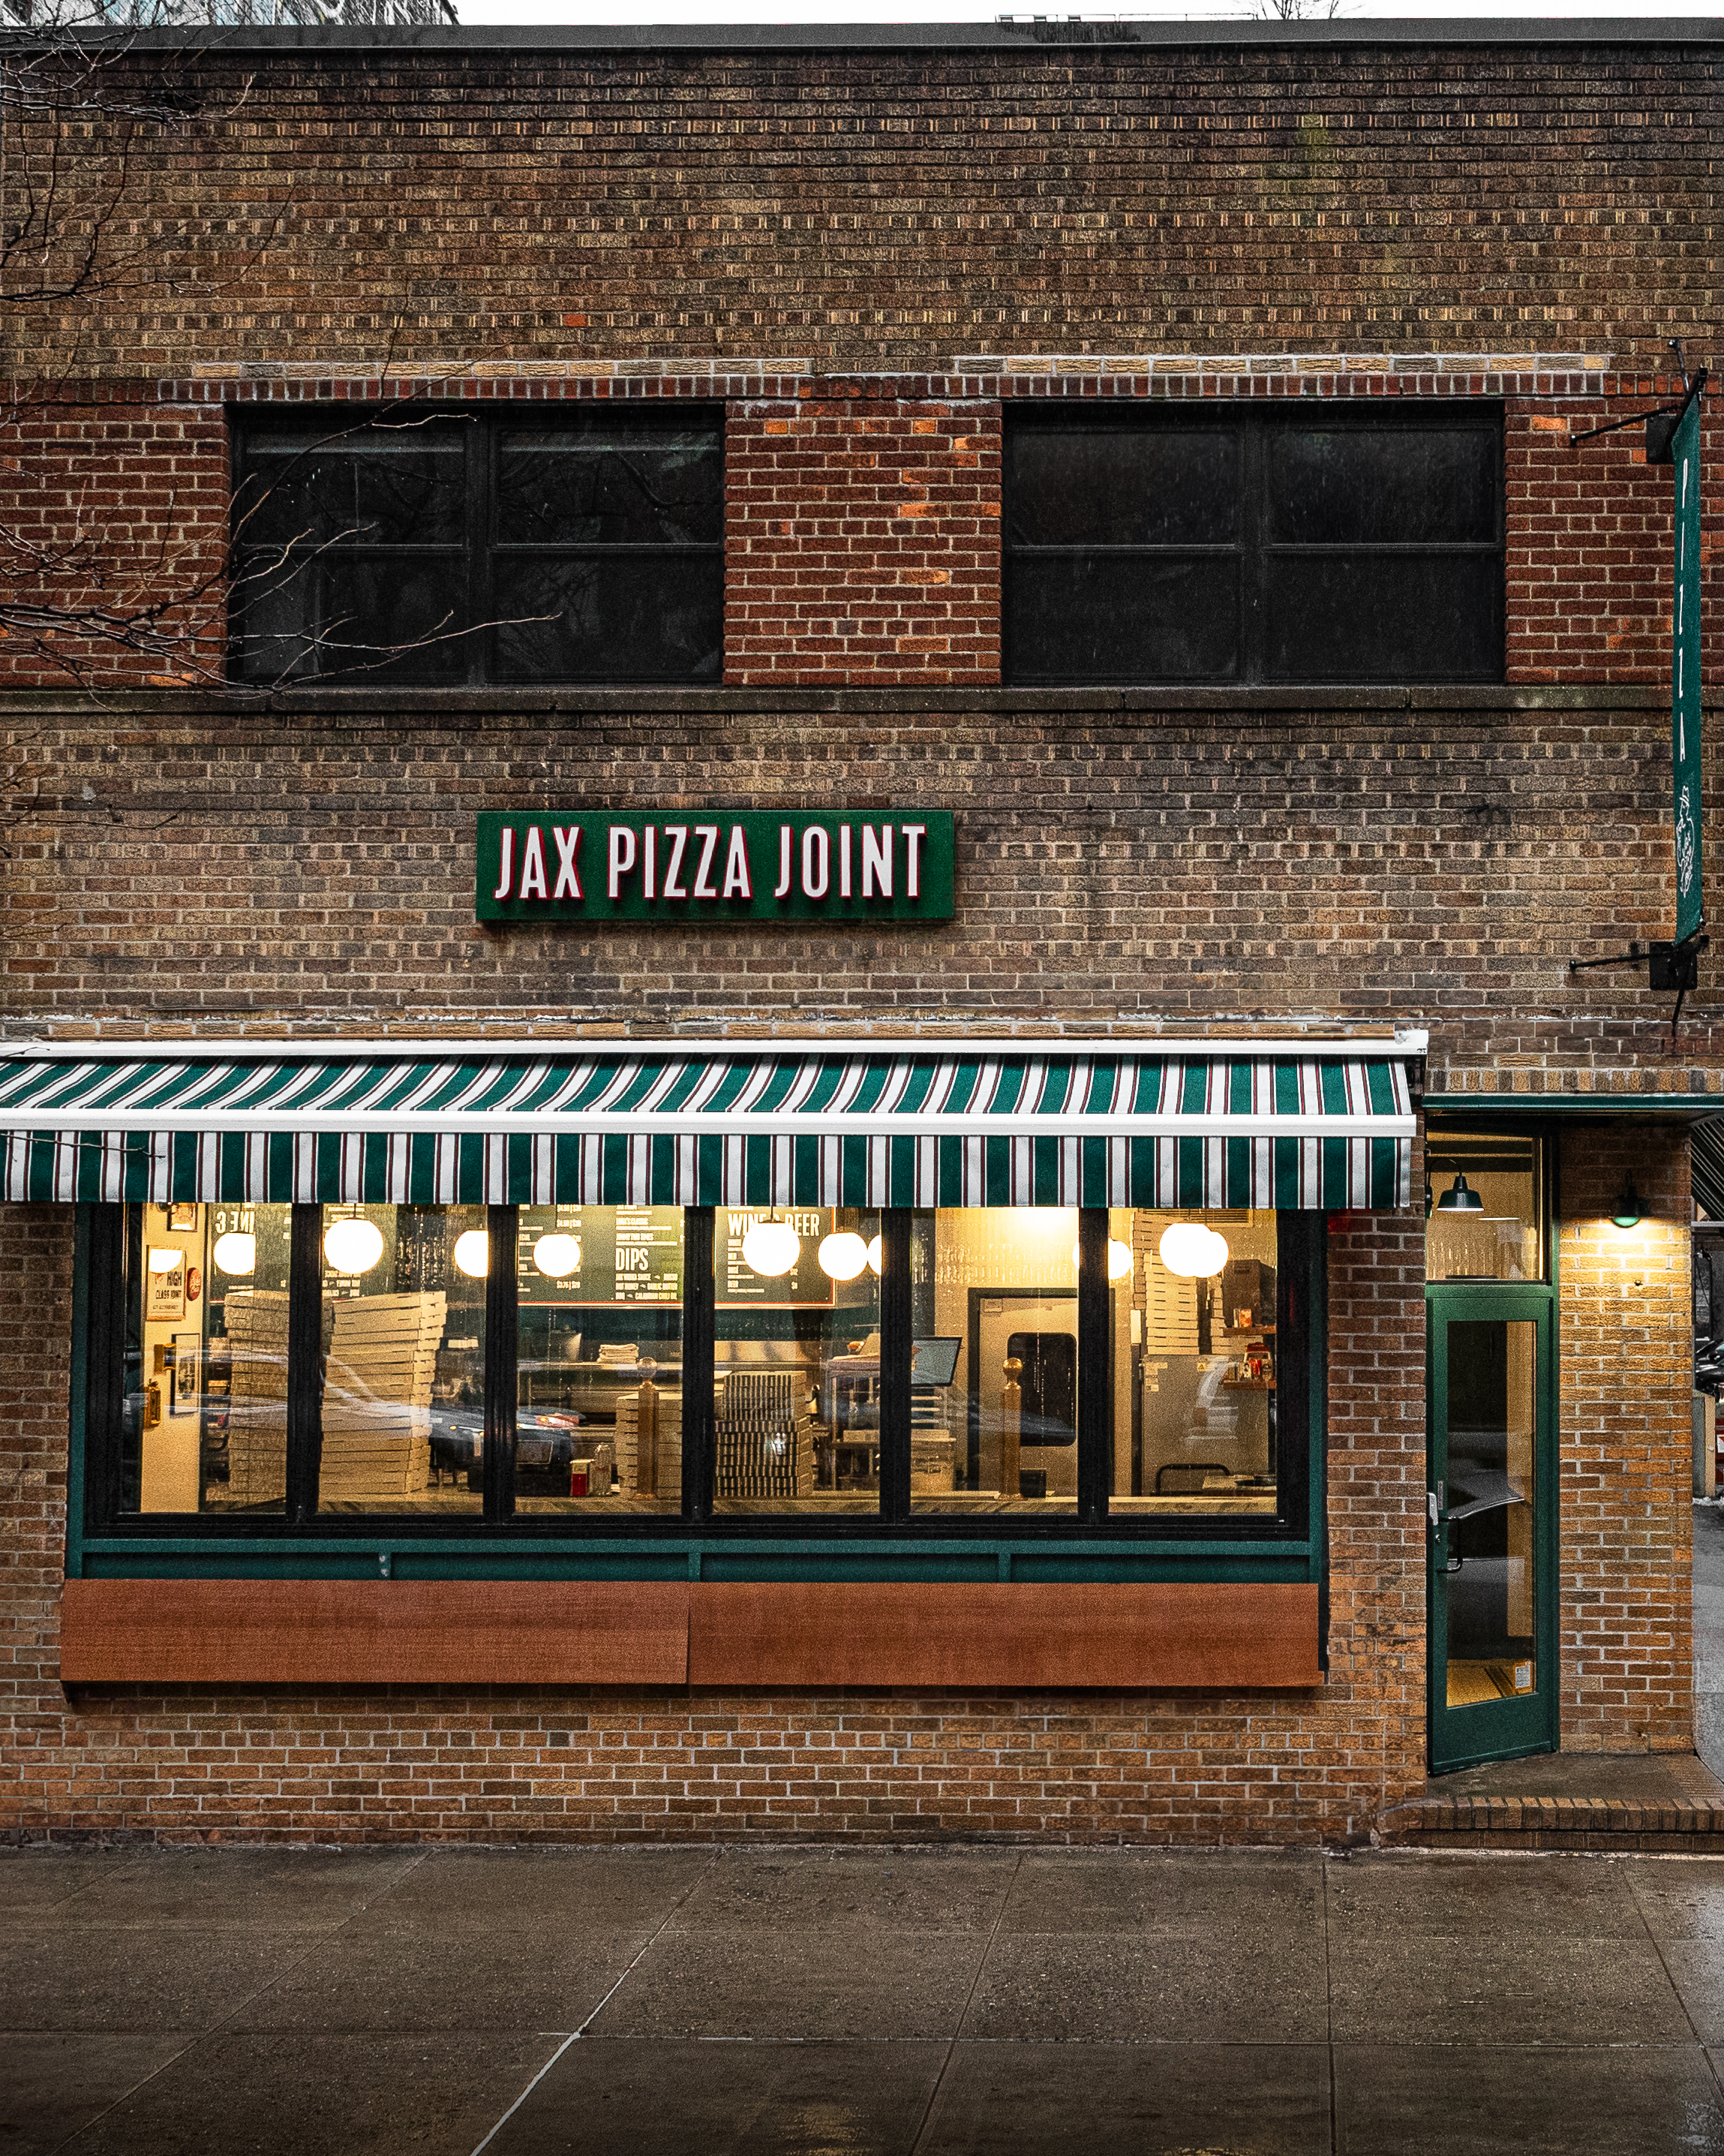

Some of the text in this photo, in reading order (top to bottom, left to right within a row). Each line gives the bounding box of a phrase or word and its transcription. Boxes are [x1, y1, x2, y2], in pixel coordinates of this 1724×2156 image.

[494, 823, 927, 900] JAX PIZZA JOINT
[615, 1248, 648, 1270] DIPS
